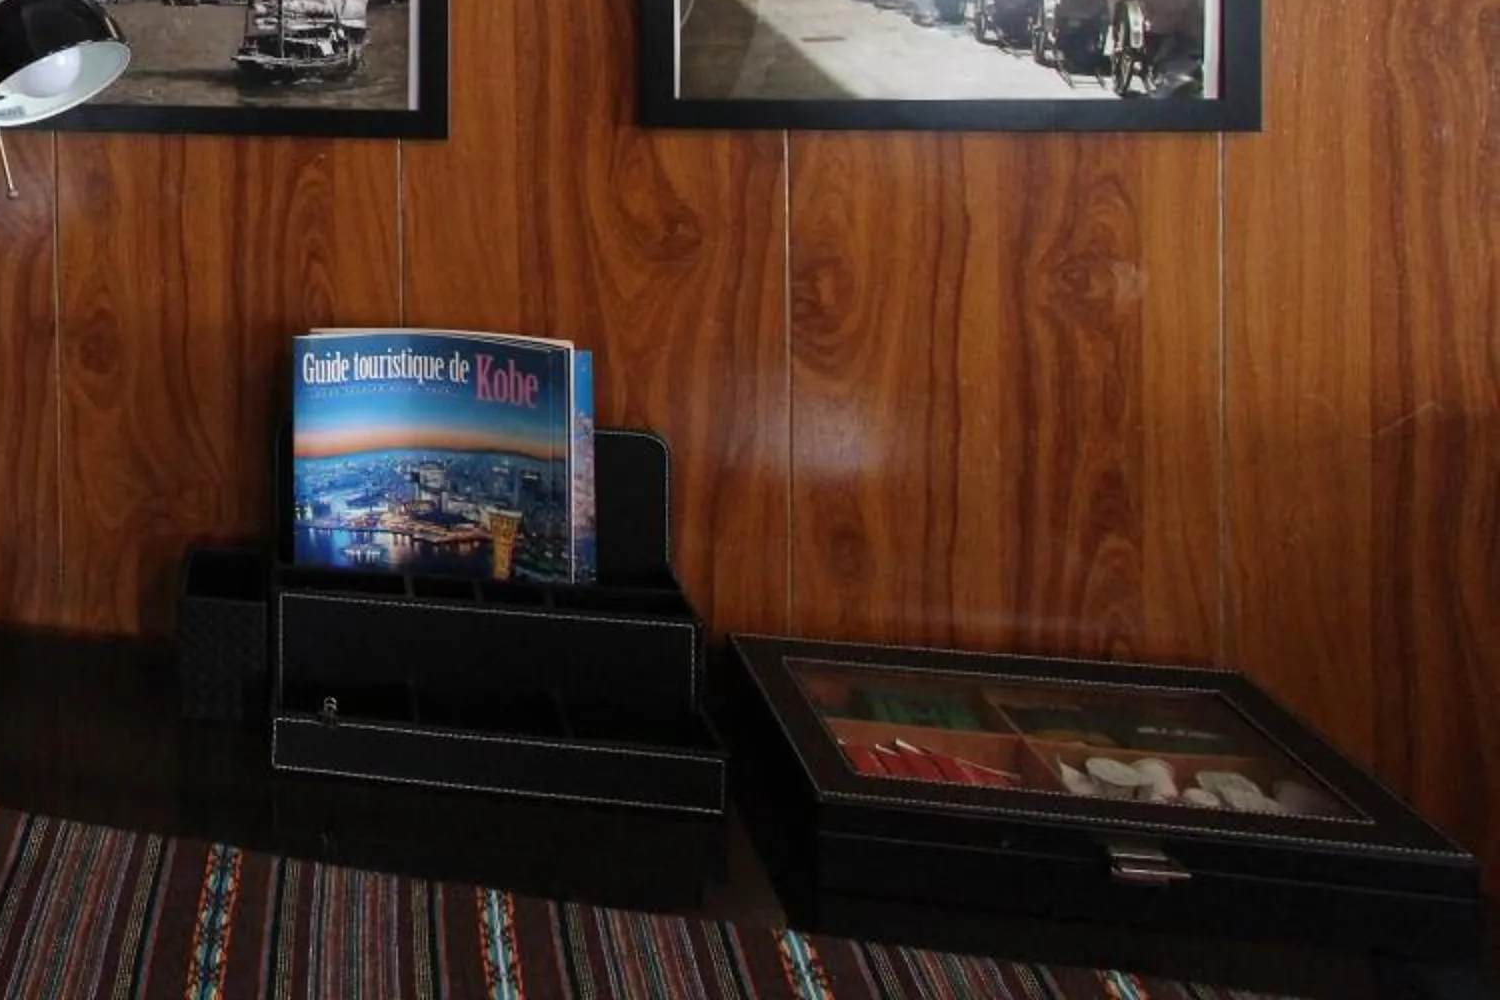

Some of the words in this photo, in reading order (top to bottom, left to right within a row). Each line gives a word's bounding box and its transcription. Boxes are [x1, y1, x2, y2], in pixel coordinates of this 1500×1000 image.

[303, 351, 349, 384] Guide
[353, 347, 445, 385] touristique
[449, 350, 471, 384] de
[474, 353, 539, 409] Kobe
